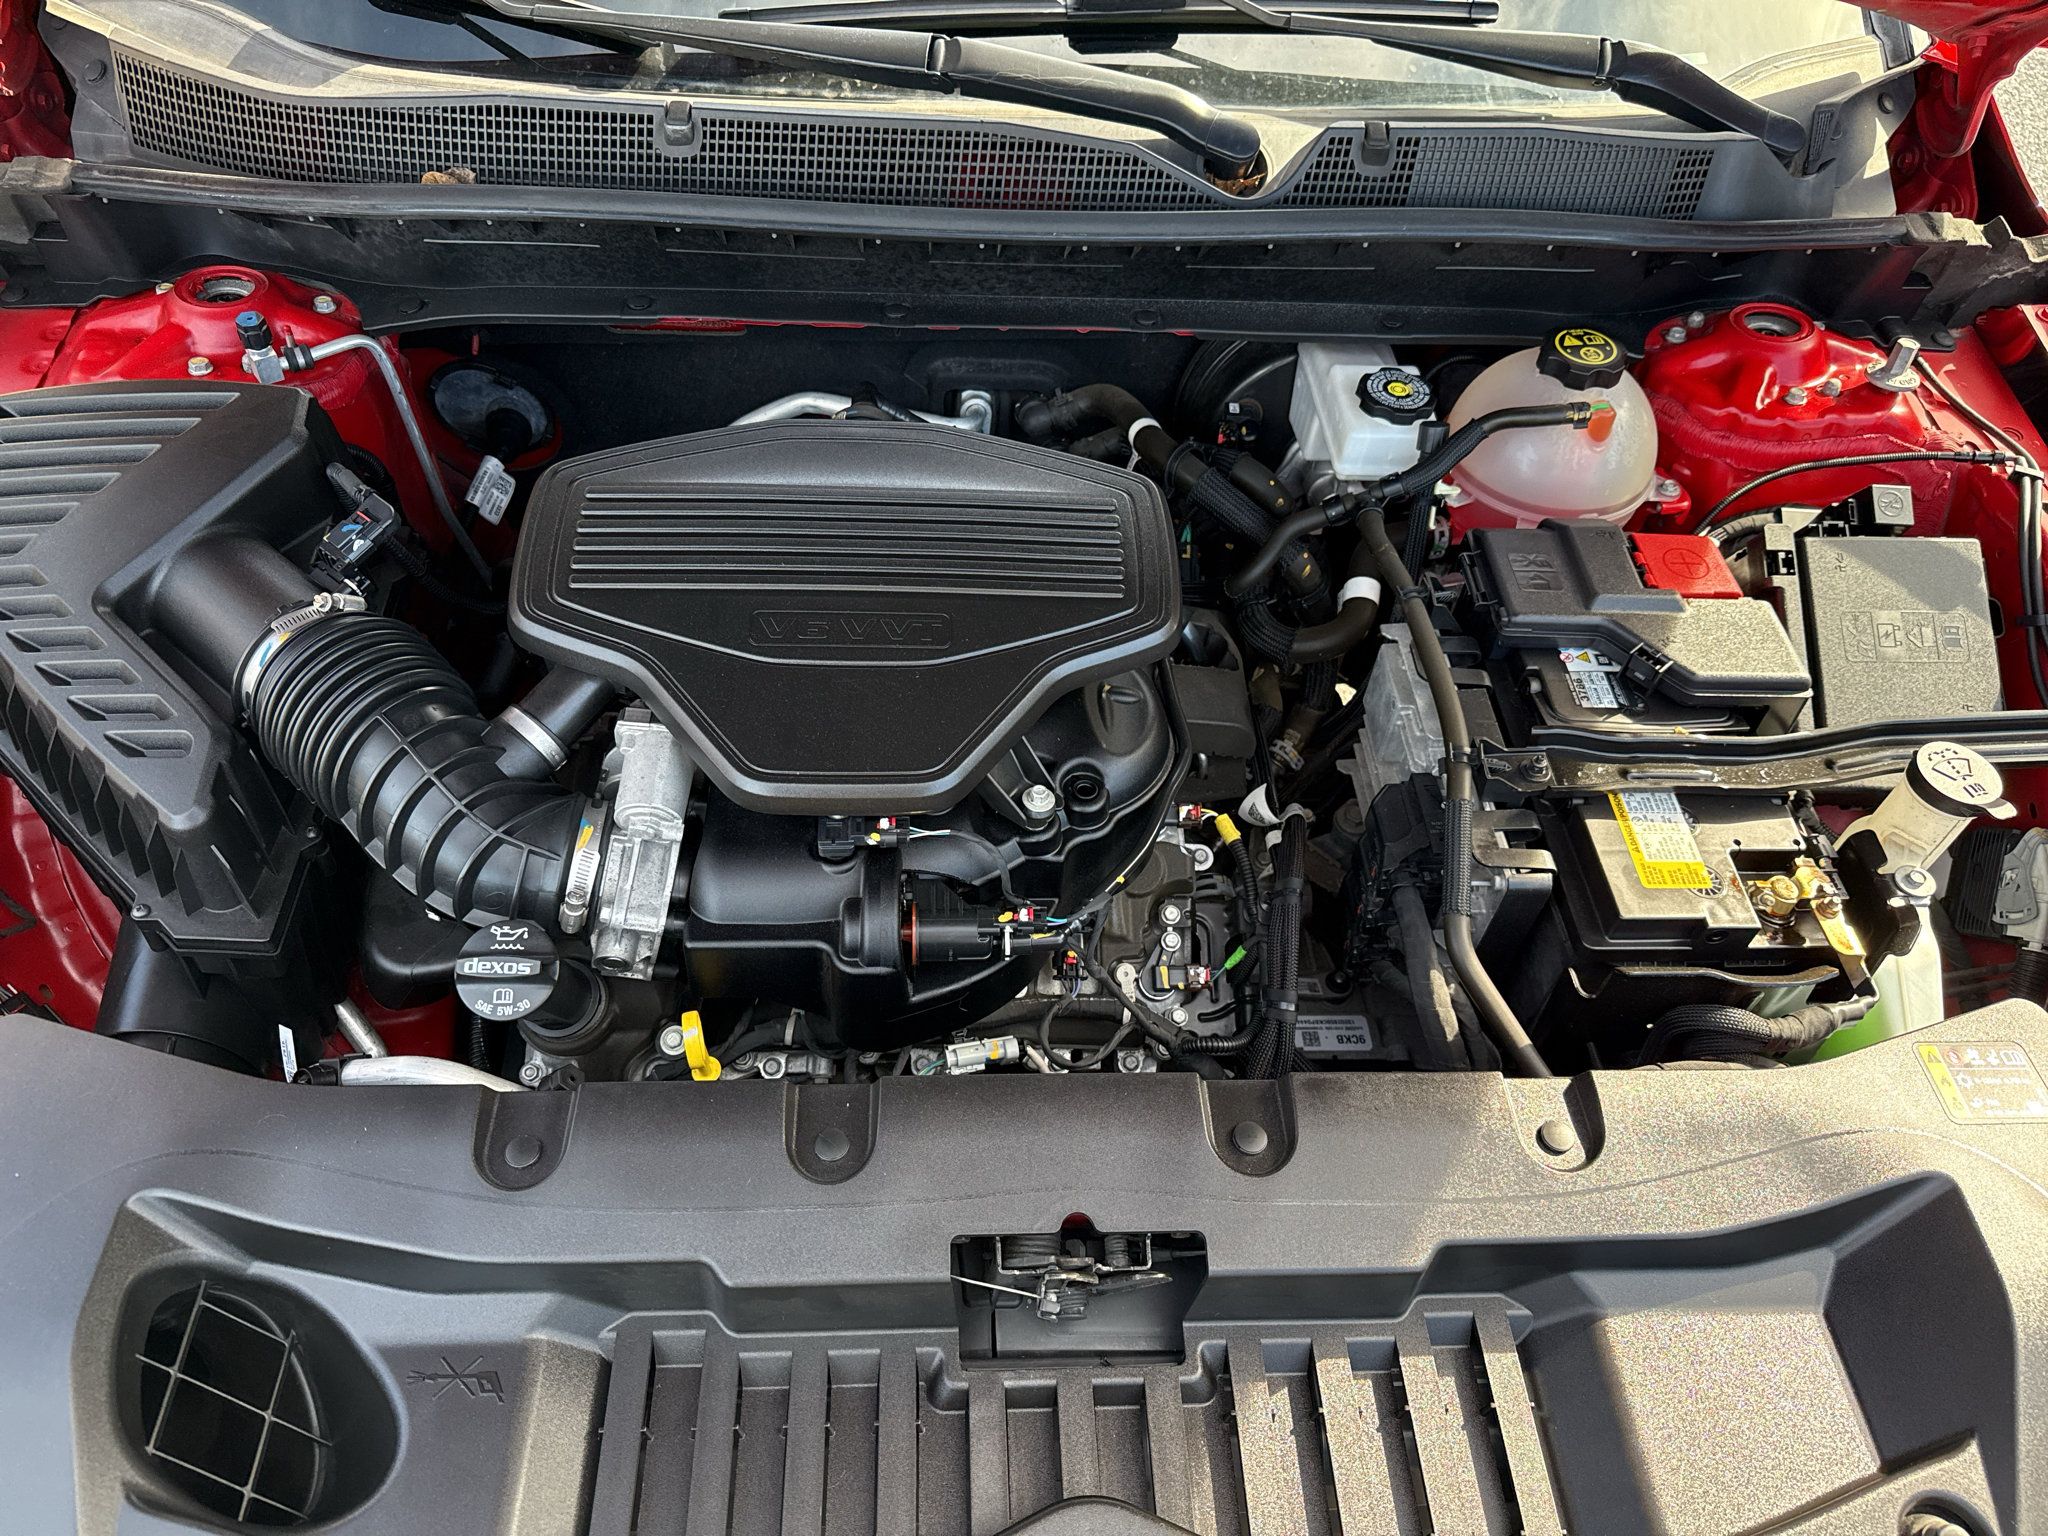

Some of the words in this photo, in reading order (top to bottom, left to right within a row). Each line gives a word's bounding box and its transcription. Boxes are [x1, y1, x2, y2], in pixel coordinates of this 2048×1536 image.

[758, 616, 830, 639] V6
[840, 617, 943, 642] VVT
[1574, 678, 1589, 702] 3786
[463, 958, 534, 974] dexos
[475, 999, 494, 1015] SAE
[496, 998, 531, 1016] 5W-30
[1336, 1035, 1366, 1044] 9CKB
